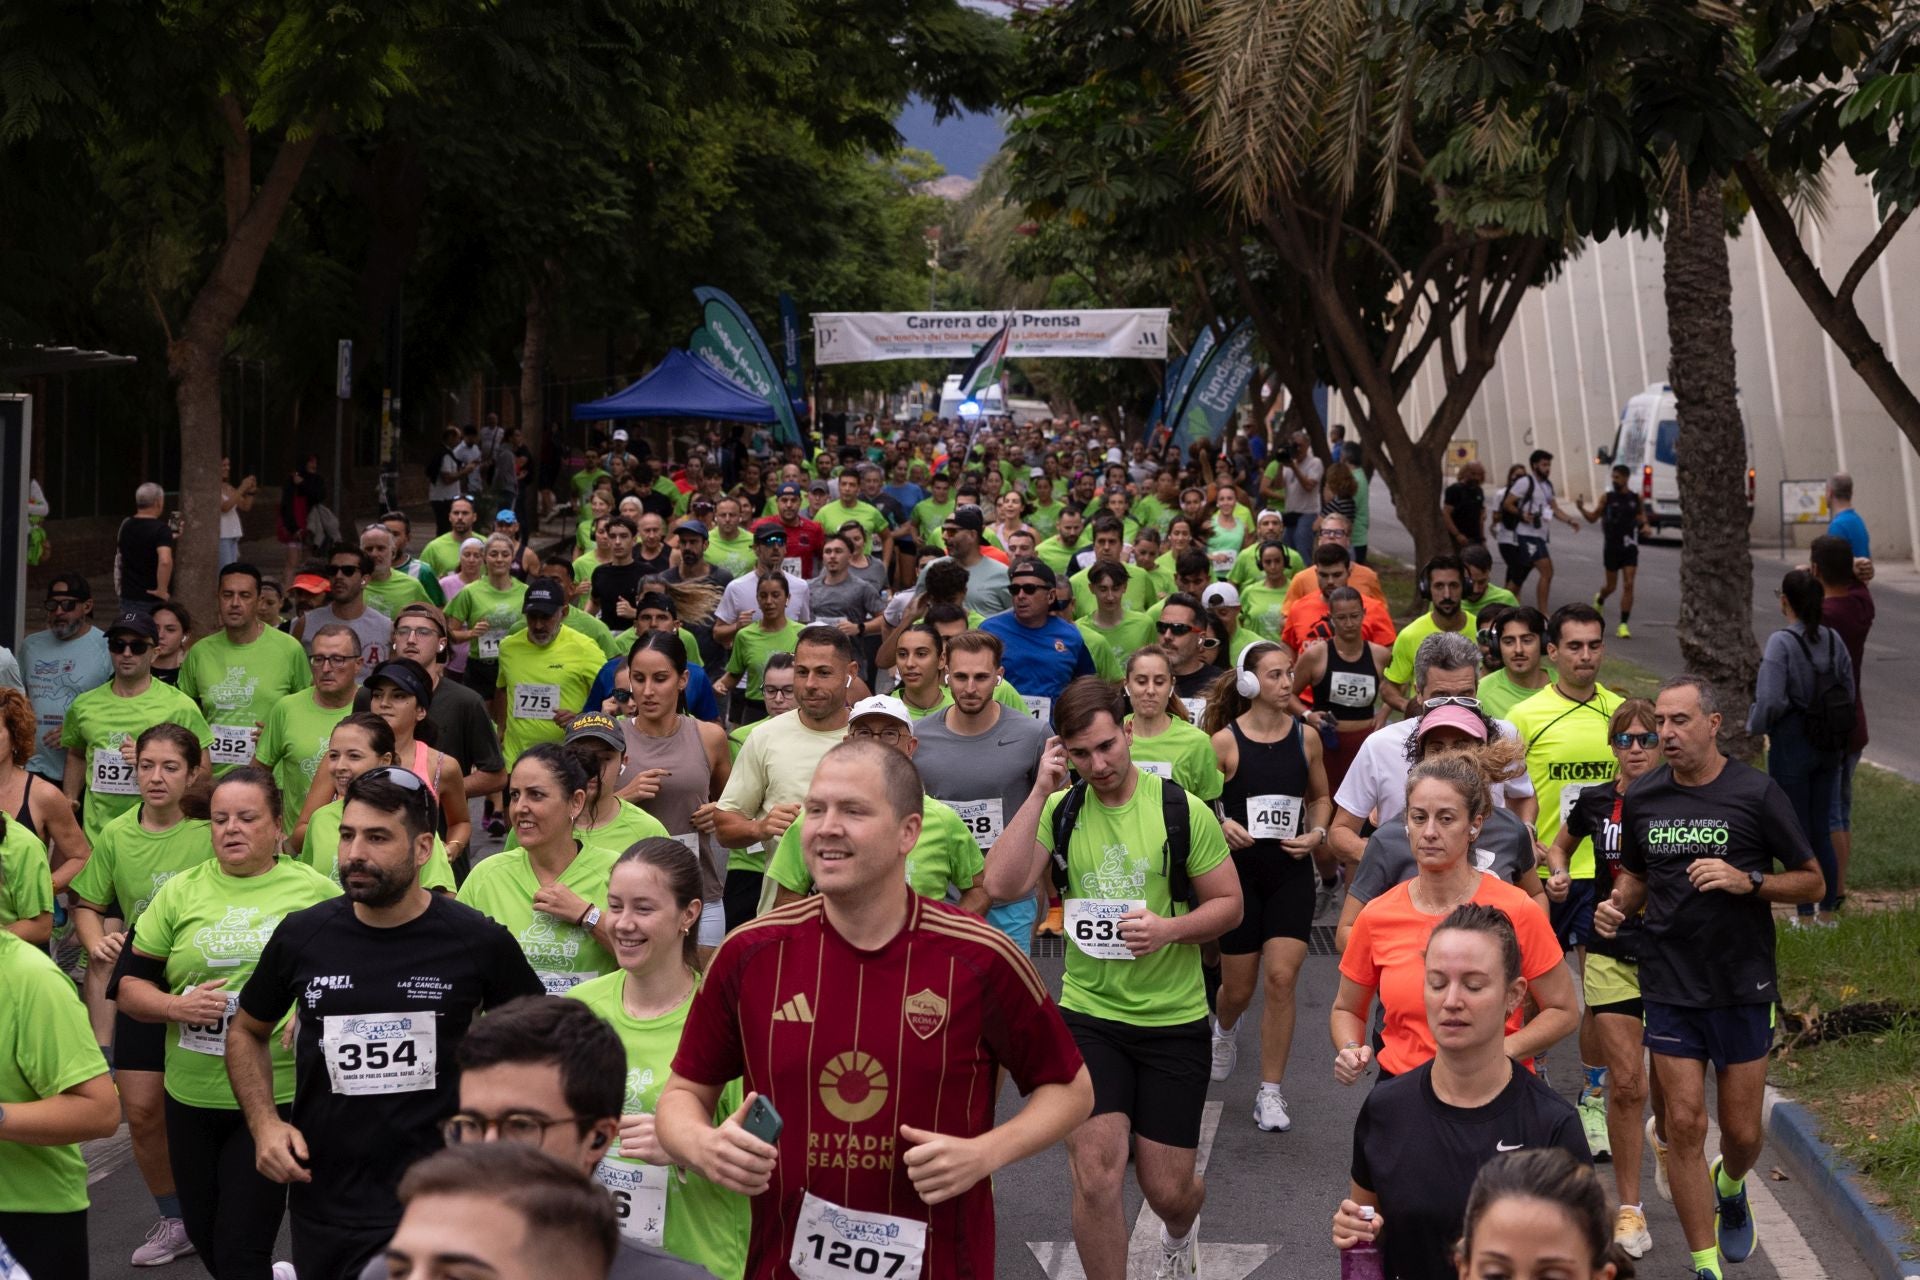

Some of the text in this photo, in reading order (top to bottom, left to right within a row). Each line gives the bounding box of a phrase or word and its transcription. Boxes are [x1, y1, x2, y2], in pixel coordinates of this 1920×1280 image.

[906, 316, 971, 329] Carrera
[976, 315, 998, 328] de
[1022, 314, 1080, 327] Prensa
[1337, 684, 1368, 698] 521
[519, 695, 551, 709] 775
[210, 738, 247, 754] 352
[98, 764, 134, 781] 637
[1256, 810, 1291, 826] 405
[1649, 818, 1729, 829] BANK OF AMERICA
[1648, 827, 1729, 845] CHICAGO
[1649, 843, 1709, 855] MARATHON
[313, 975, 350, 987] PORFI
[414, 982, 452, 990] CANCELAS
[354, 1020, 402, 1033] Carrera
[912, 1015, 938, 1026] ROMA
[366, 1030, 406, 1039] Prensa
[338, 1040, 418, 1071] 354
[808, 1132, 895, 1151] RIYADH
[807, 1152, 894, 1170] SEASON
[833, 1214, 887, 1236] Carrera
[807, 1234, 906, 1279] 1207
